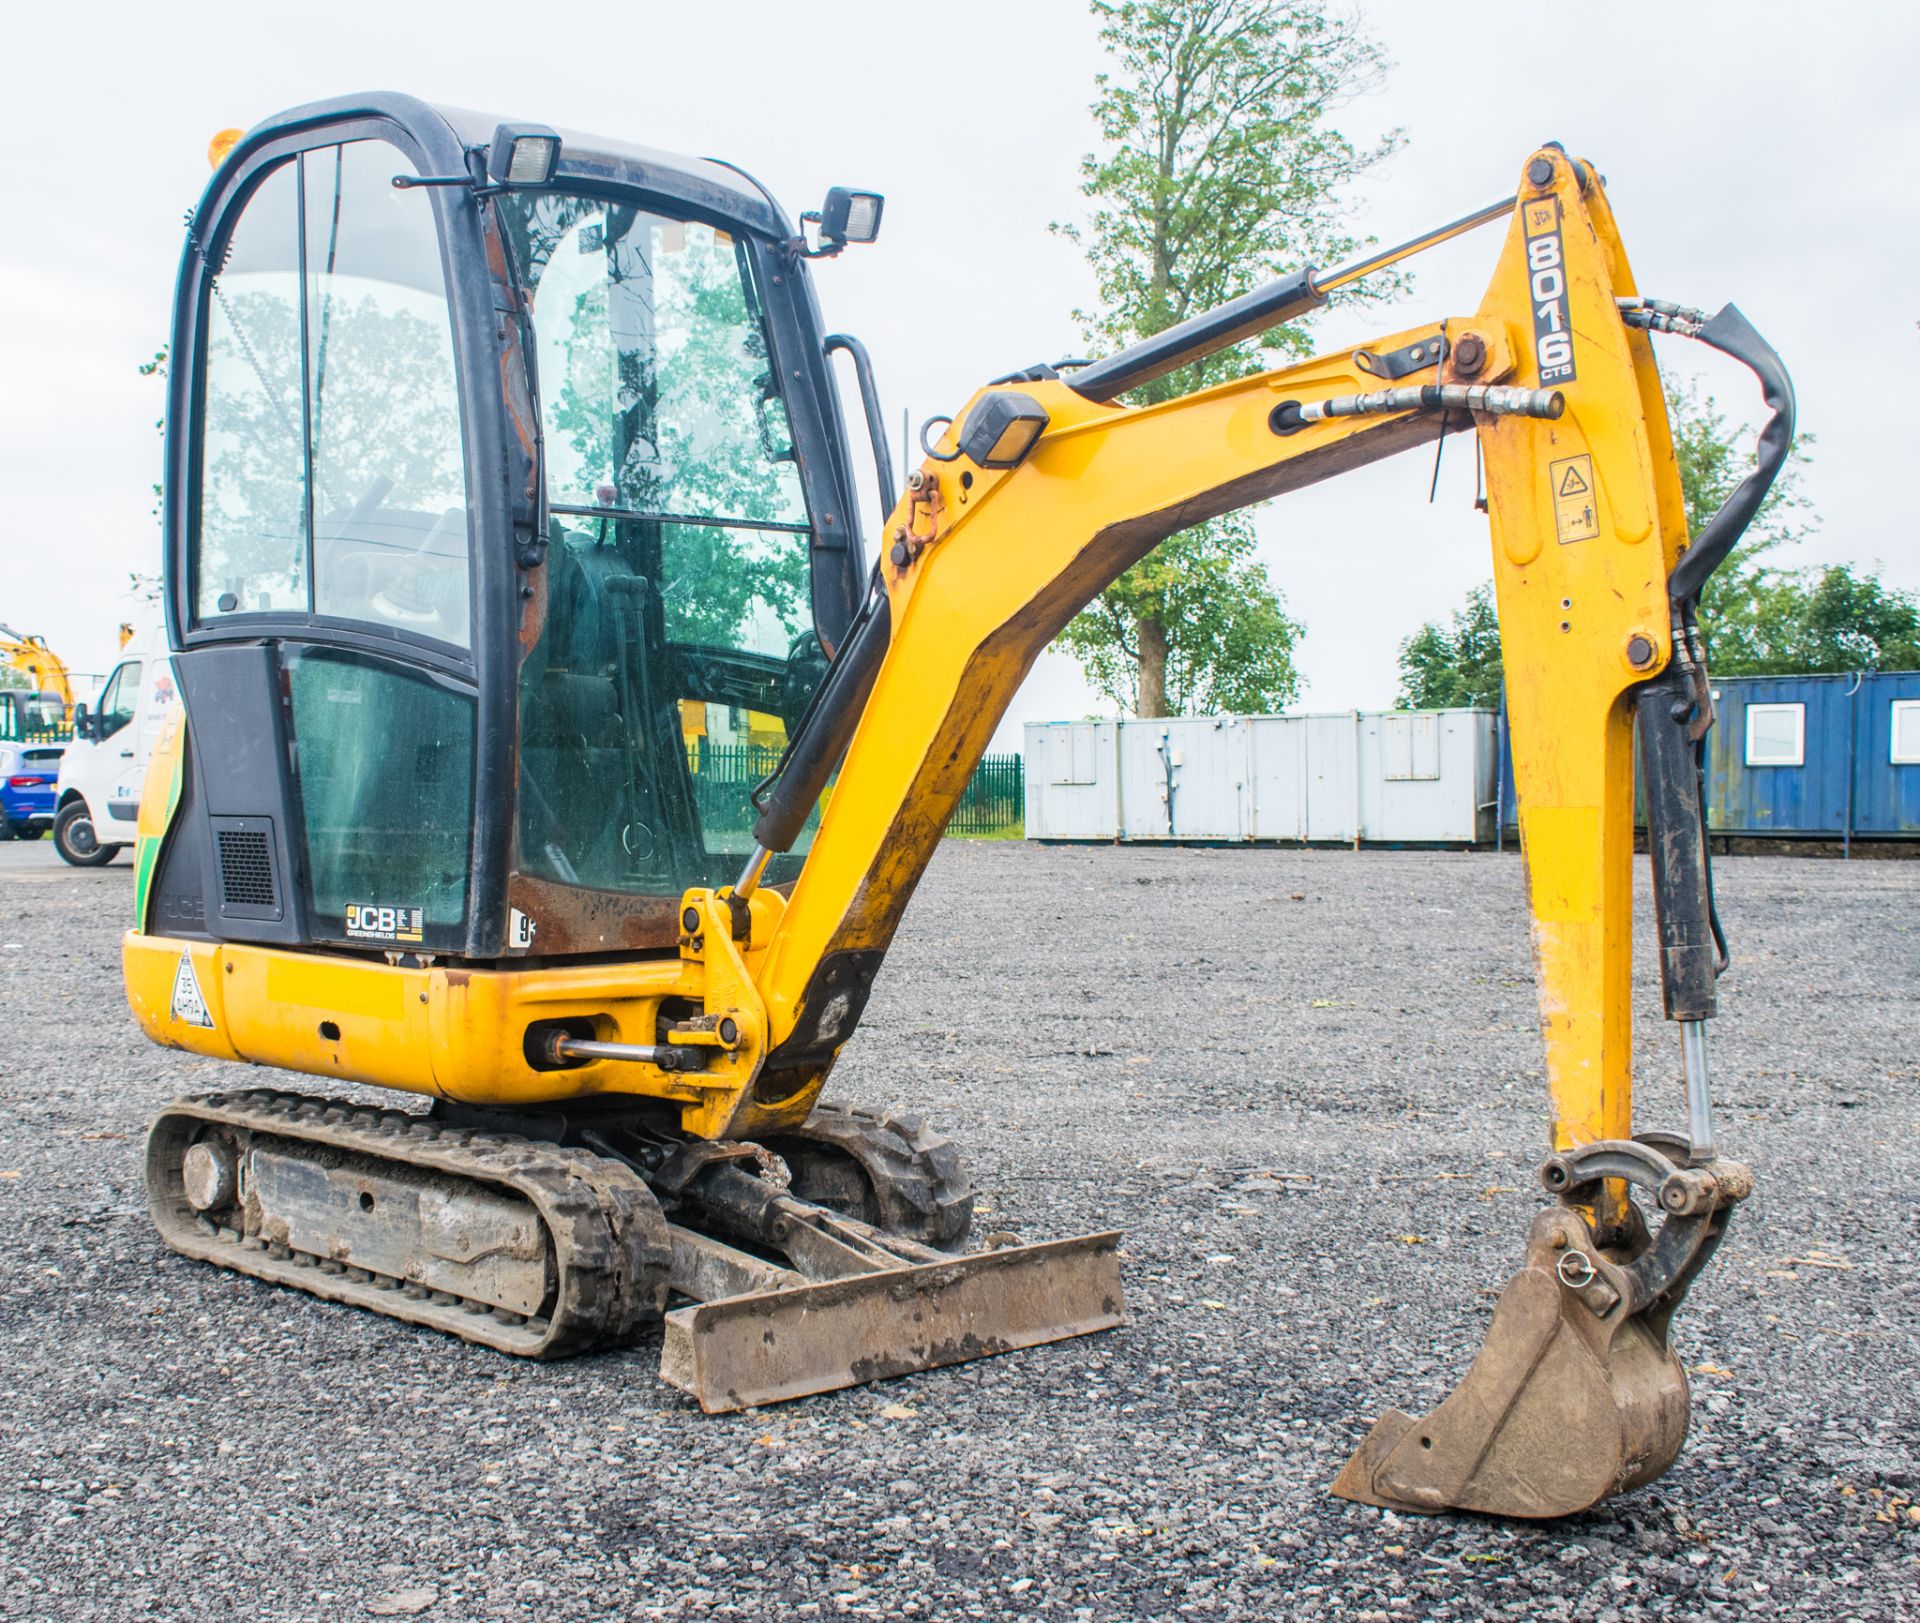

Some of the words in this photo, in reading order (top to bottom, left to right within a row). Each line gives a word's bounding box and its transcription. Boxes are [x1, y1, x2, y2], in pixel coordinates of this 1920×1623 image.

[1532, 209, 1553, 227] JCB
[1528, 235, 1572, 369] 8016
[1541, 364, 1573, 380] CTS
[347, 905, 396, 932] JCB
[346, 929, 395, 940] GREENSHIELDS
